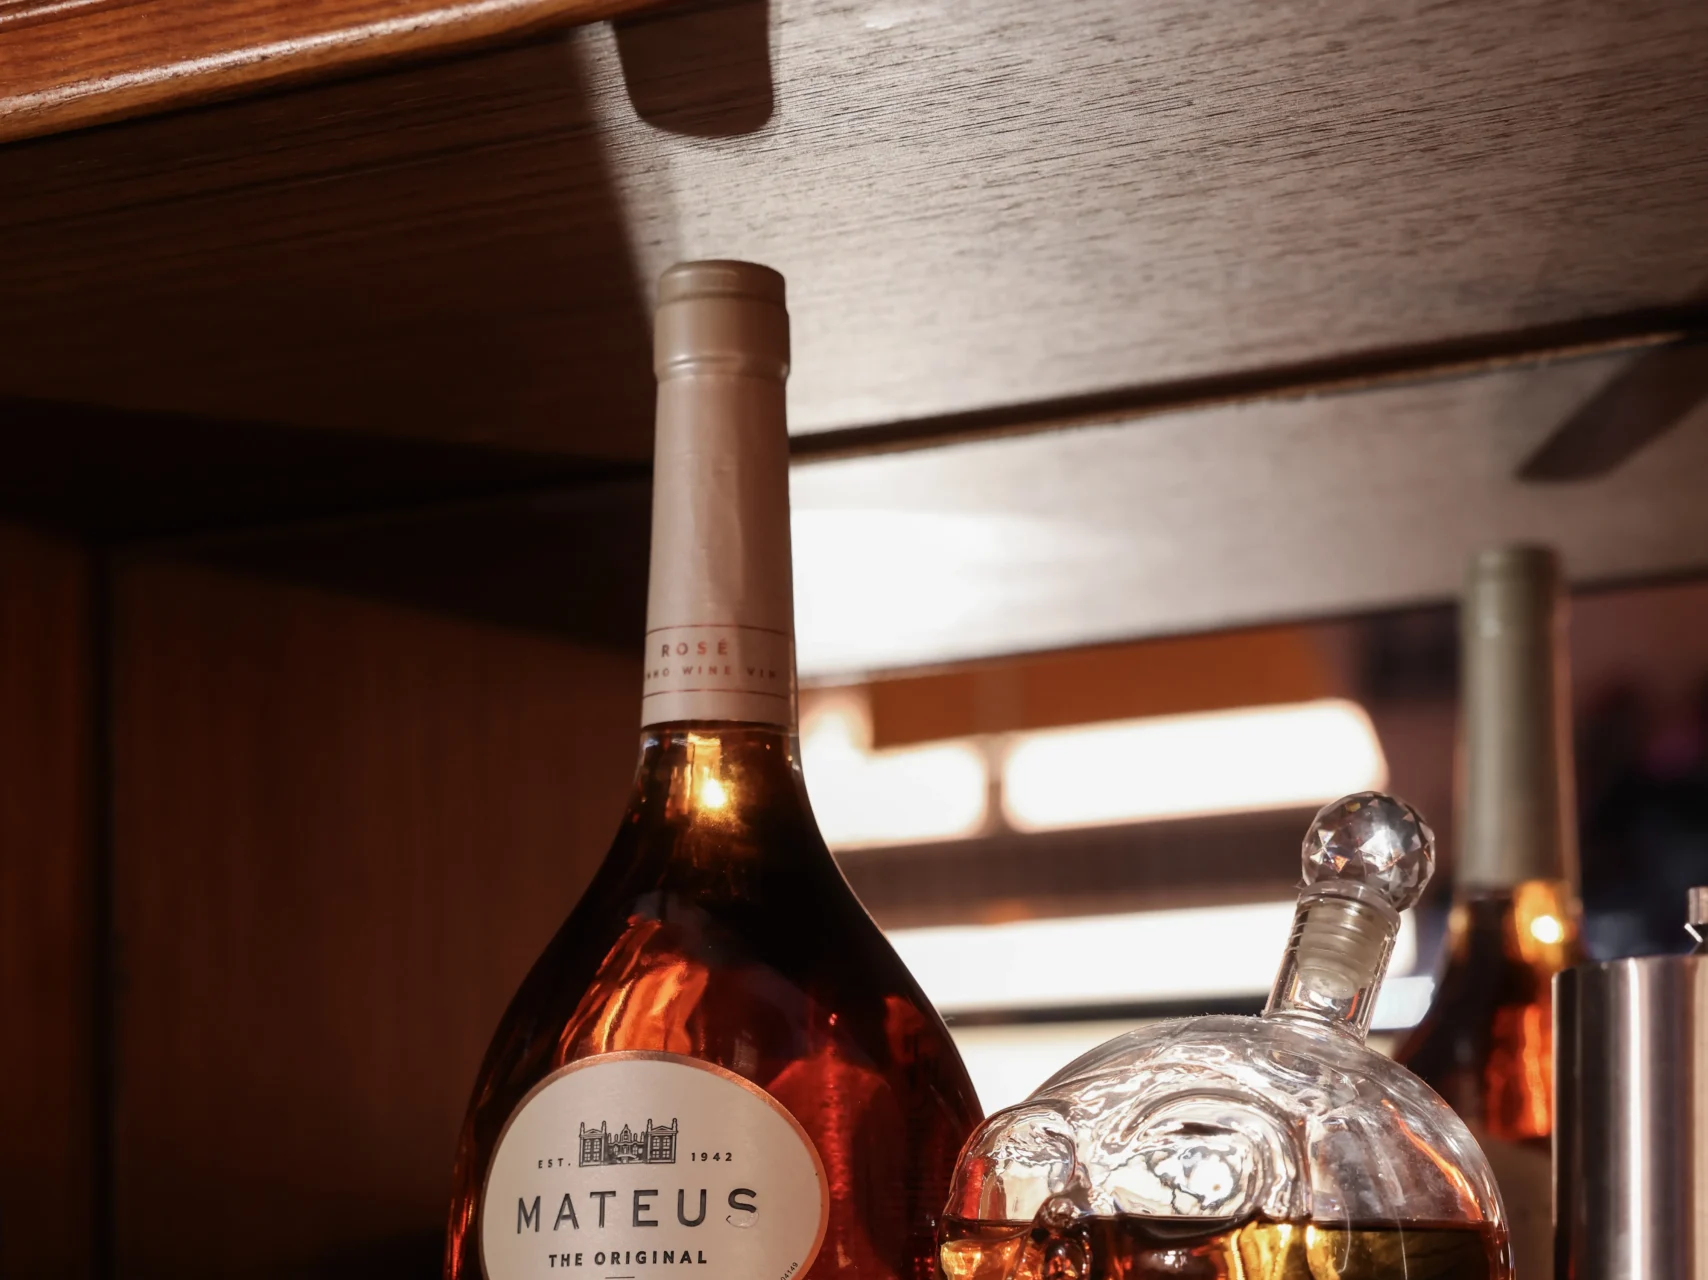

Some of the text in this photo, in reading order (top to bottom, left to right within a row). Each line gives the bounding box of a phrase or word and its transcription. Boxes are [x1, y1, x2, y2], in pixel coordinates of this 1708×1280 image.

[661, 638, 728, 658] ROSÉ
[683, 666, 732, 676] WINE
[538, 1152, 733, 1169] EST. 1942
[517, 1188, 759, 1234] MATEUS
[549, 1250, 707, 1268] THE ORIGINAL
